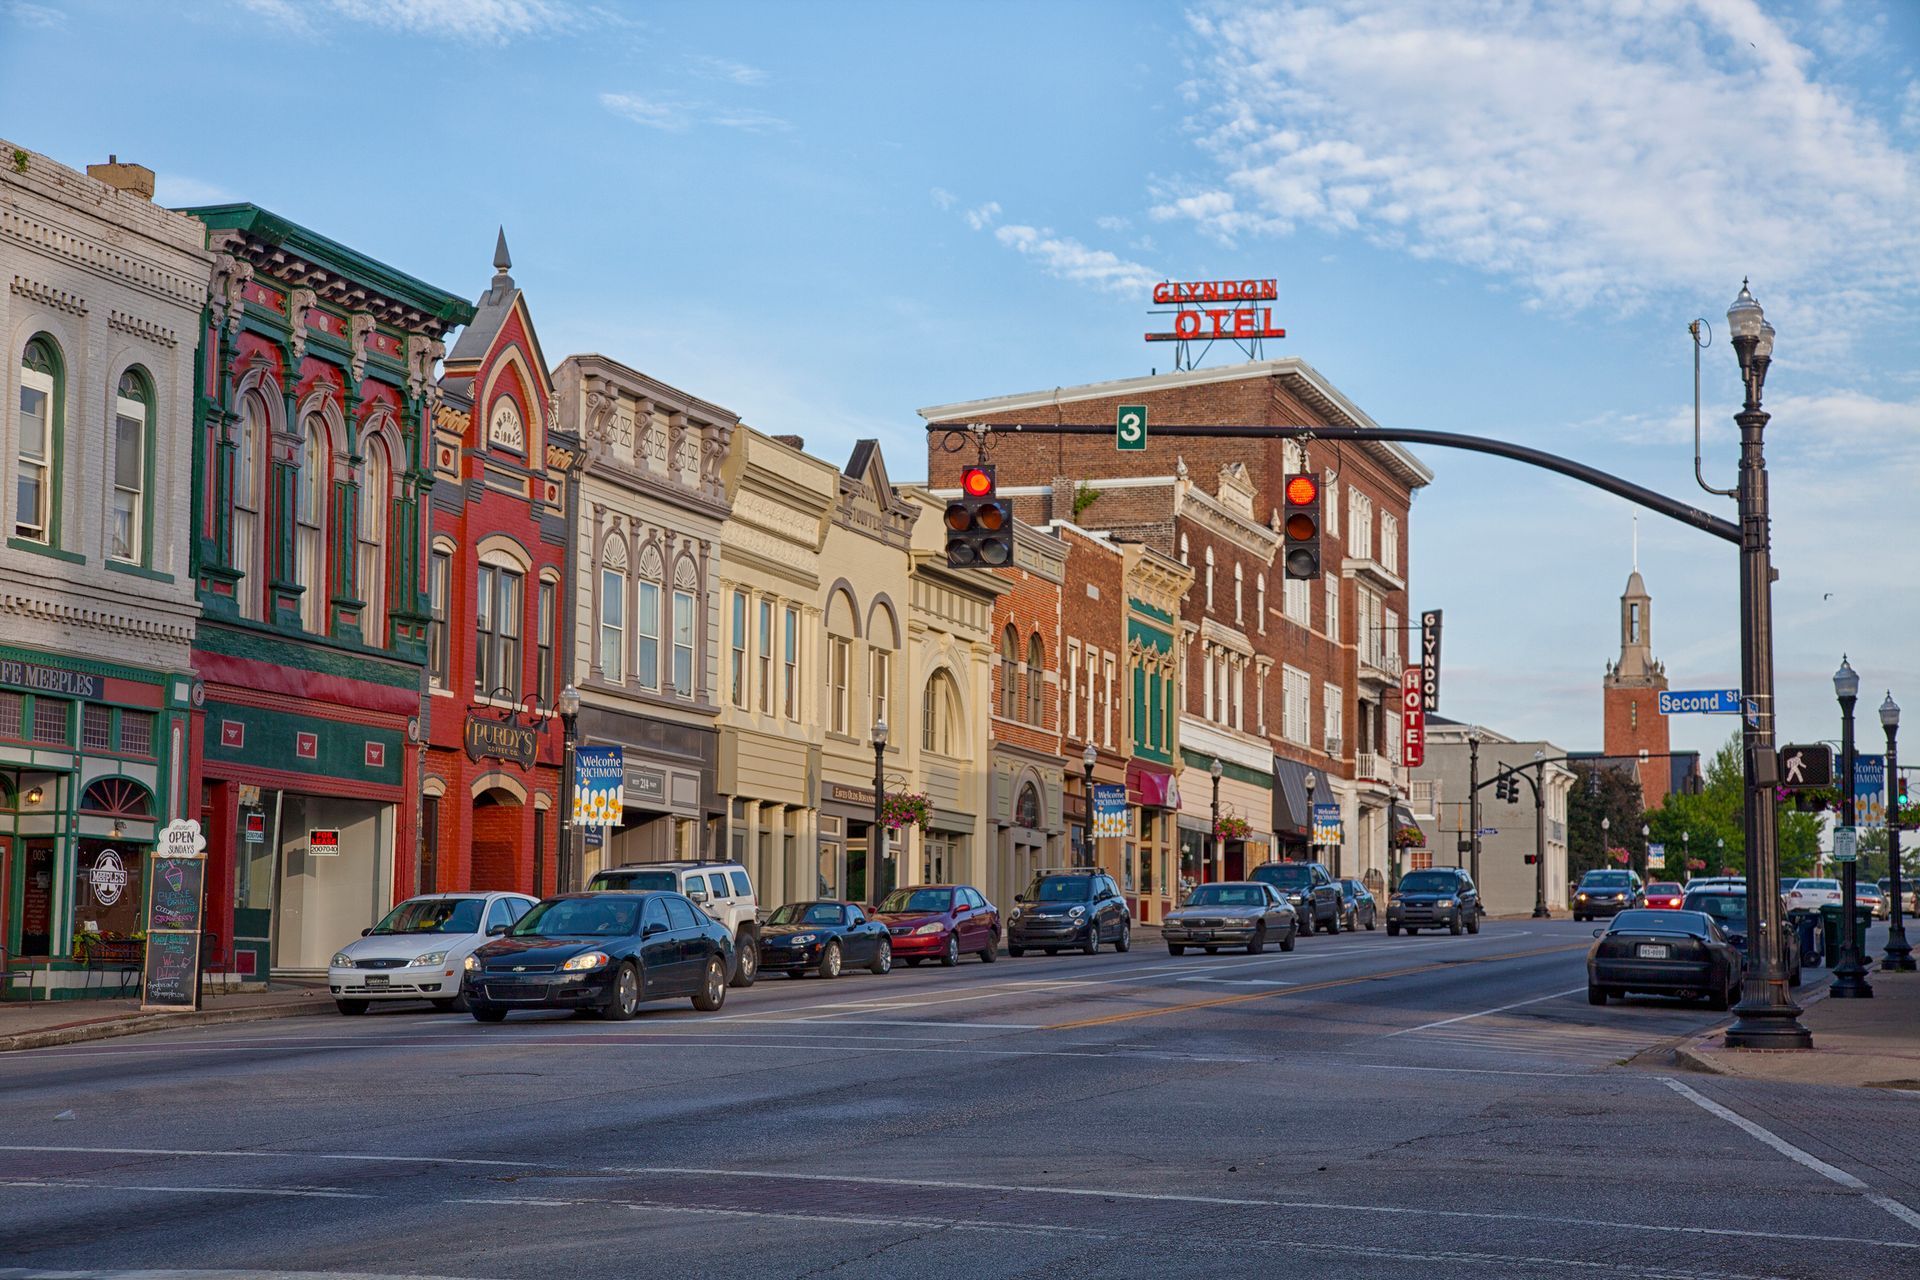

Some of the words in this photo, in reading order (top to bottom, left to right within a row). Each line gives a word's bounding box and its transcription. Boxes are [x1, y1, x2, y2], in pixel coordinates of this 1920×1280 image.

[1153, 279, 1277, 303] GLYNDON
[1175, 308, 1285, 339] OTEL
[1120, 414, 1141, 441] 3
[1424, 613, 1436, 708] GLYNDON
[25, 665, 93, 696] MEEPLES
[1661, 693, 1719, 711] Second
[1726, 691, 1738, 702] St
[1406, 674, 1420, 762] HOTEL
[473, 723, 533, 755] PURDY'S
[582, 755, 621, 767] Welcome
[1855, 762, 1883, 773] lcome
[581, 767, 623, 778] RICHMOND
[1098, 791, 1124, 799] Welcome
[168, 831, 195, 843] OPEN
[167, 844, 195, 855] SUNDAYS
